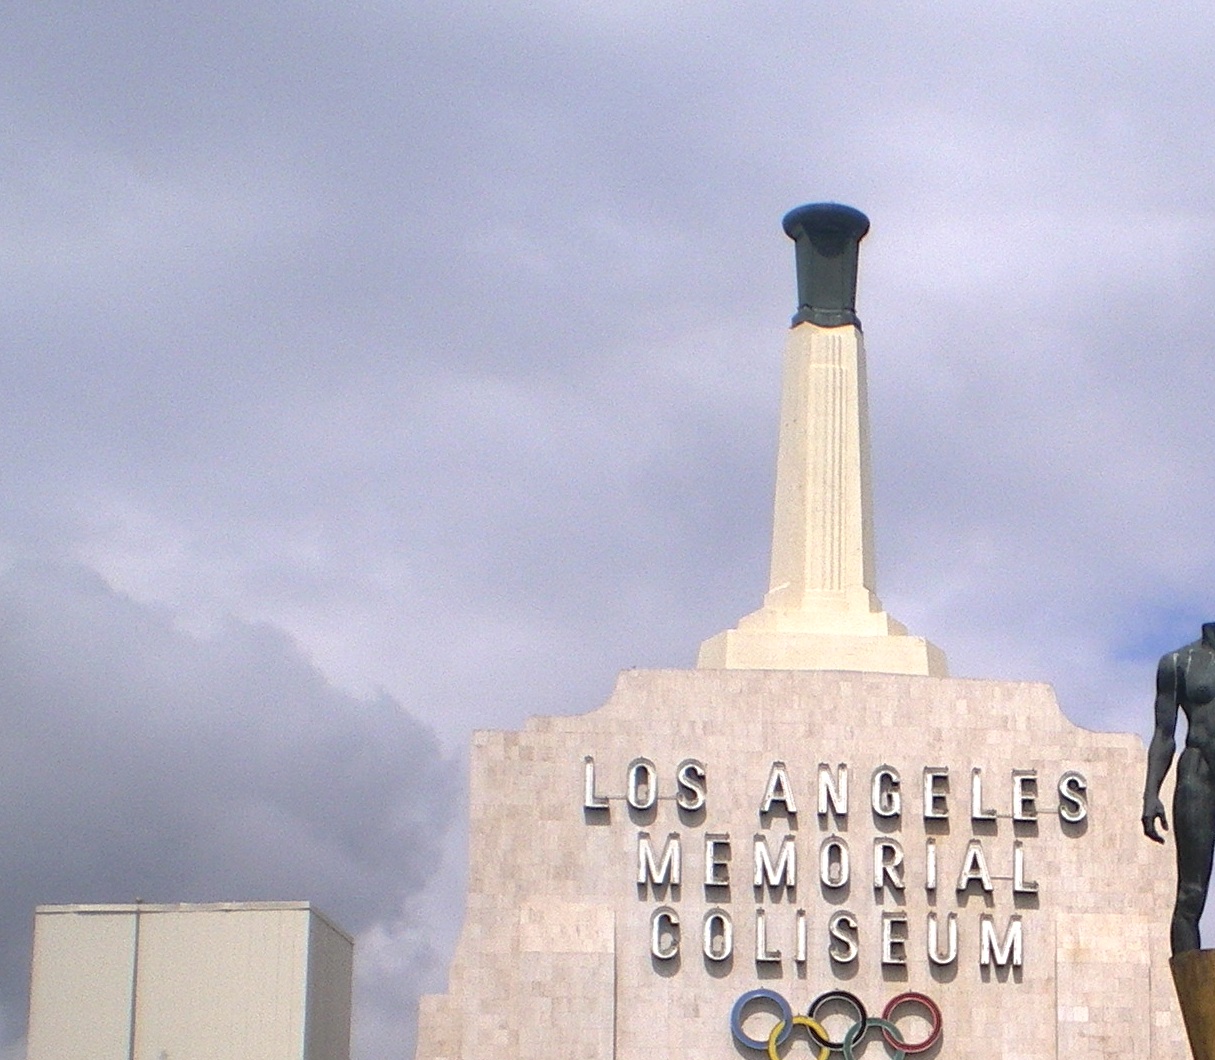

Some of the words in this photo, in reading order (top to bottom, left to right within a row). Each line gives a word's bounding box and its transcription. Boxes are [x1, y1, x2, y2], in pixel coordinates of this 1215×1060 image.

[584, 757, 706, 811] LOS
[760, 763, 1087, 823] ANGELES
[637, 833, 1039, 892] MEMORIAL
[651, 907, 1023, 966] COLISEUM
